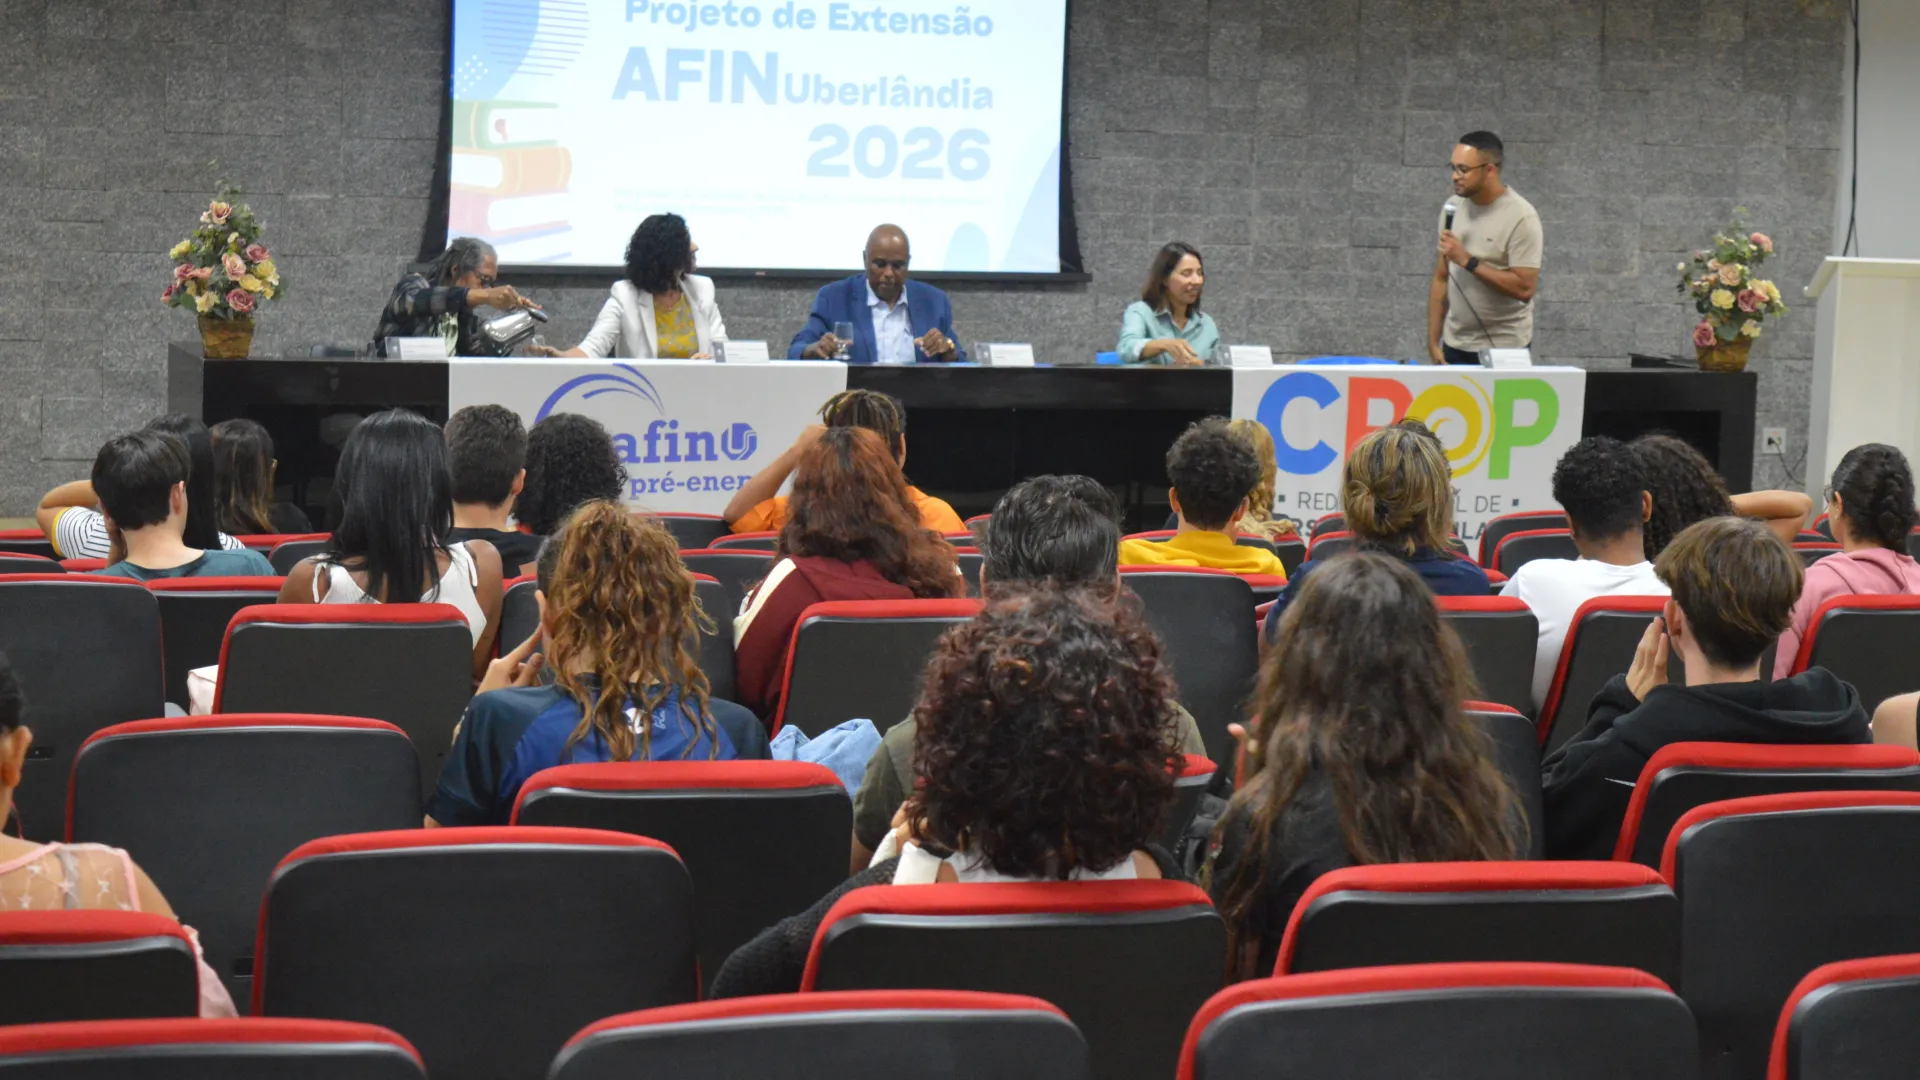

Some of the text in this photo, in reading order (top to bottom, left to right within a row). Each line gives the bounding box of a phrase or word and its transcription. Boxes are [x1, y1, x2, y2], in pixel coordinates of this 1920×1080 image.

[625, 0, 994, 37] Projeto de Extensão
[611, 46, 994, 109] AFIN Uberlândia
[806, 122, 991, 182] 2026
[613, 419, 719, 464] afin
[1298, 491, 1338, 511] RED
[1475, 495, 1502, 513] DE
